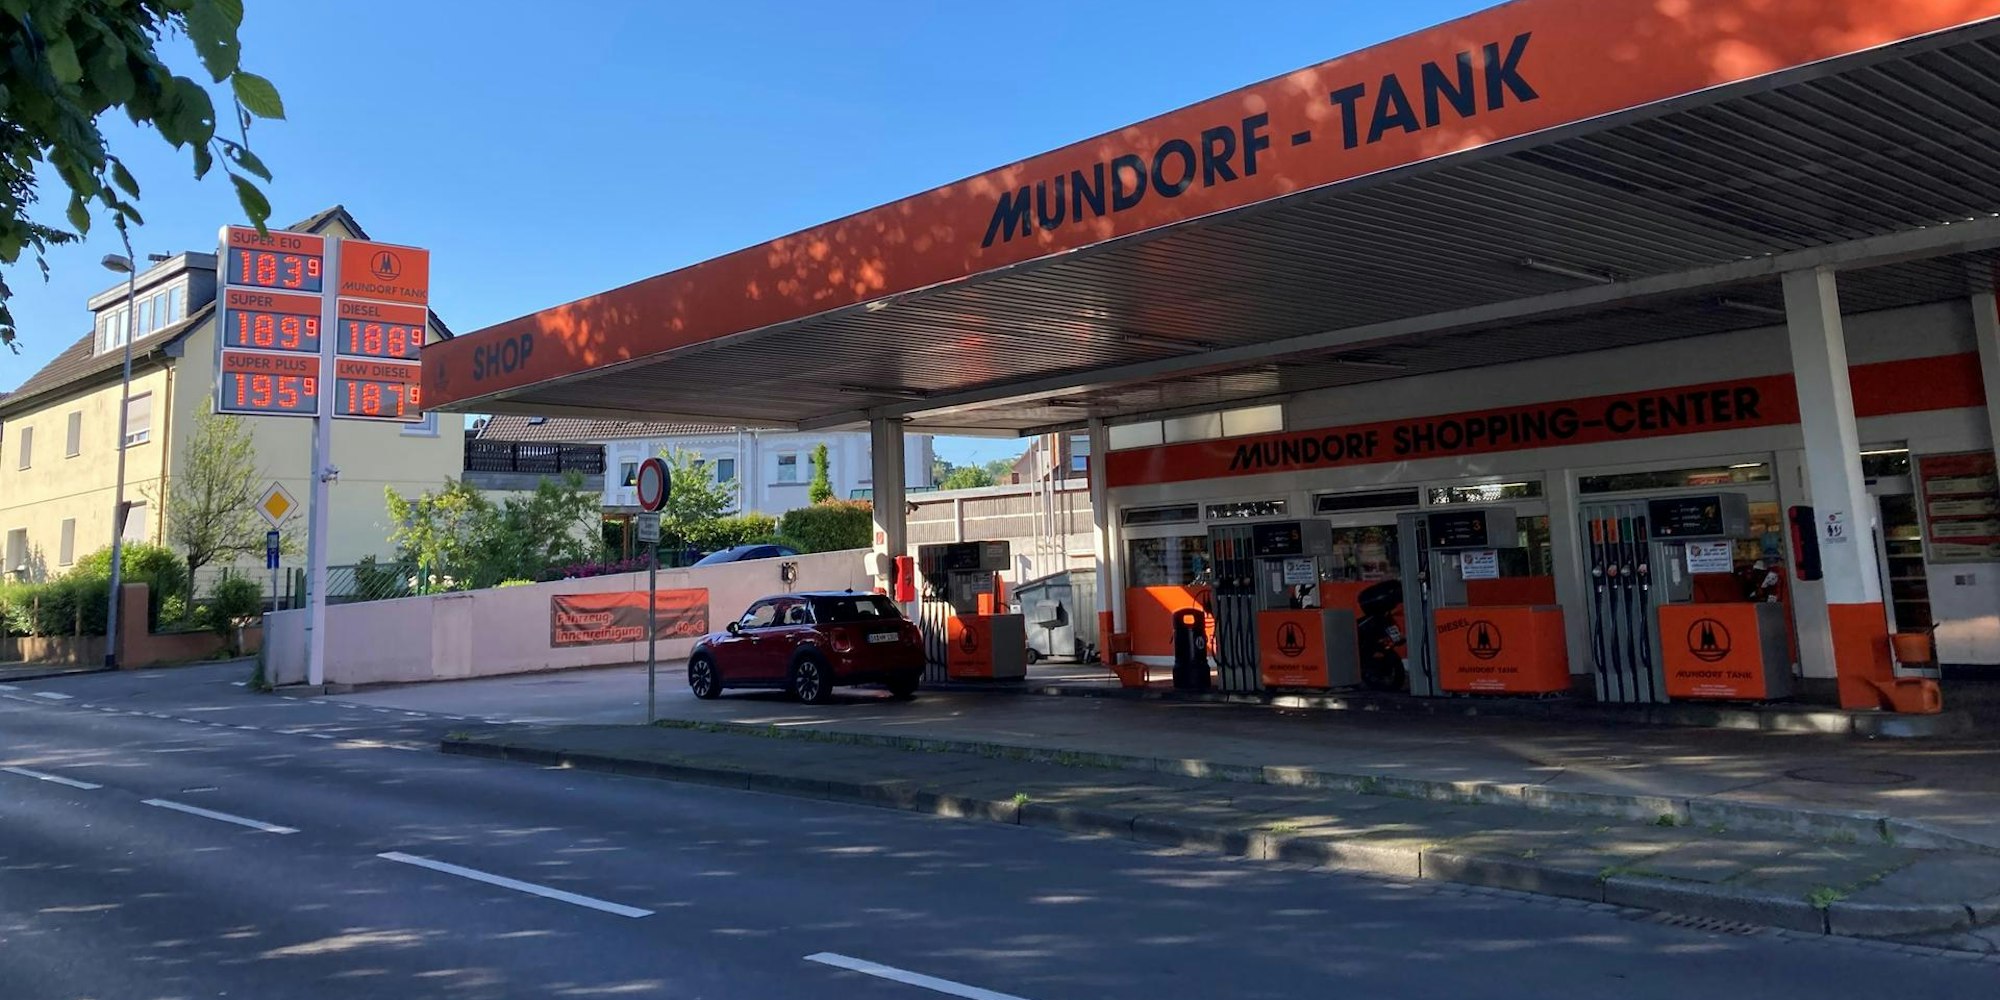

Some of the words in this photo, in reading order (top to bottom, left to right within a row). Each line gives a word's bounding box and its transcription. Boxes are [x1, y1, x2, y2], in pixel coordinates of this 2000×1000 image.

[980, 112, 1270, 248] MUNDORF
[1330, 32, 1540, 150] TANK
[233, 232, 275, 246] SUPER
[280, 238, 301, 249] E10
[342, 282, 398, 294] MUNDORF
[400, 287, 427, 298] TANK
[231, 294, 273, 307] SUPER
[342, 303, 381, 317] DIESEL
[227, 356, 271, 369] SUPER
[275, 359, 307, 371] PLUS
[473, 333, 534, 381] SHOP
[340, 363, 368, 375] LKW
[373, 366, 411, 378] DIESEL
[1229, 430, 1379, 471] MUNDORF
[1437, 618, 1471, 633] DIESEL
[1726, 671, 1753, 680] TANK
